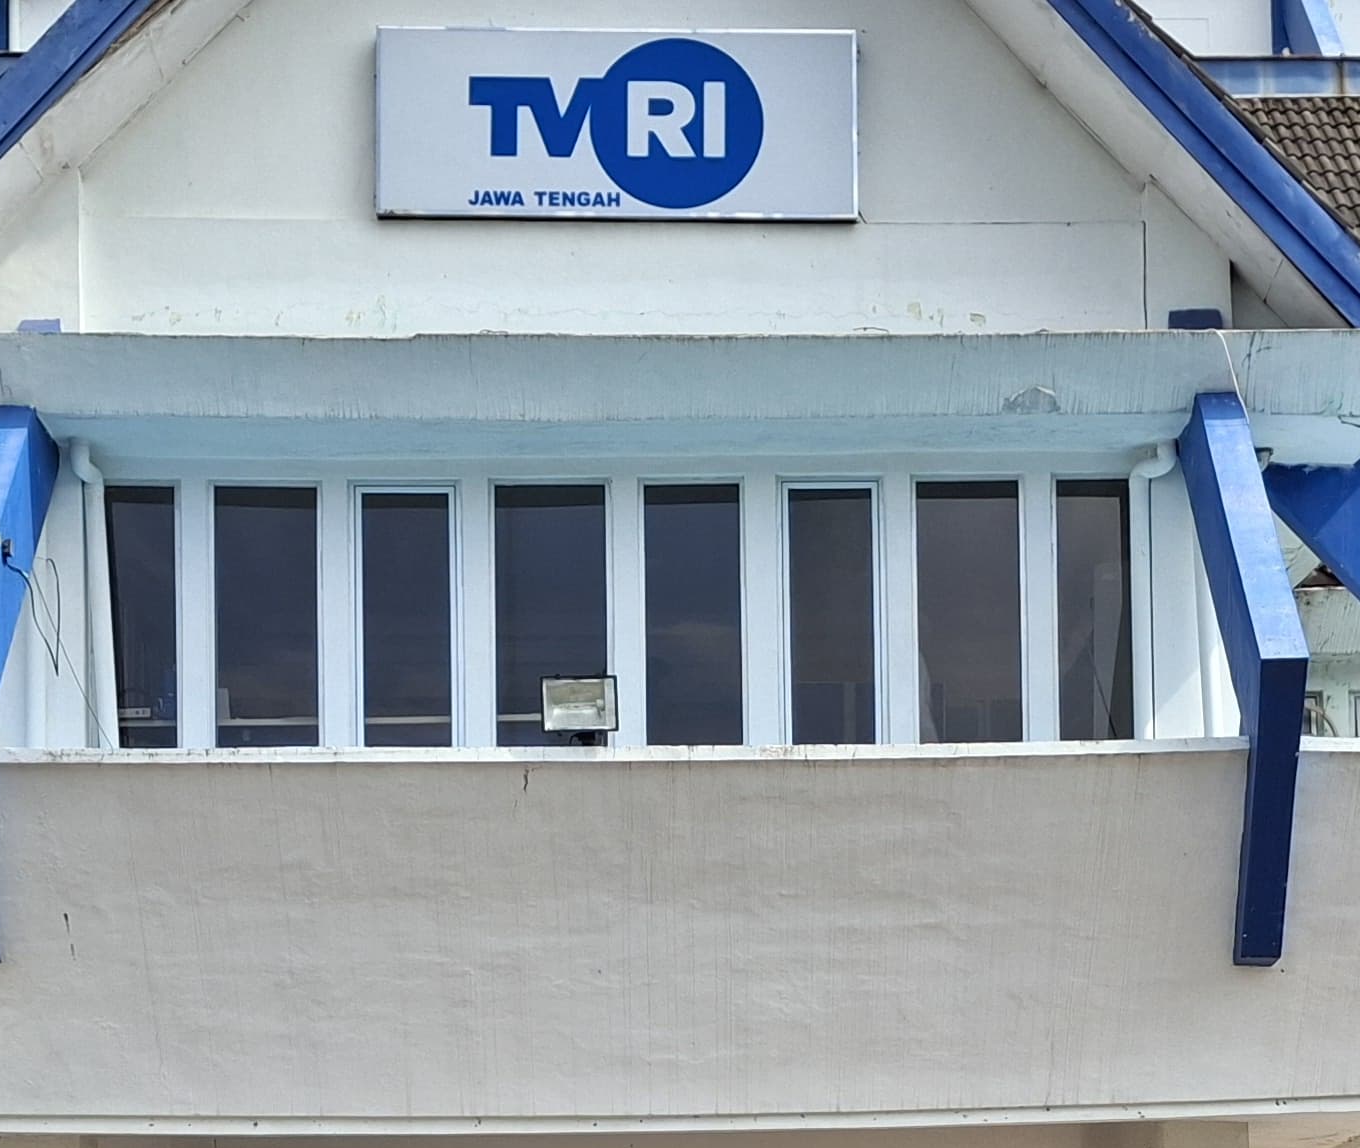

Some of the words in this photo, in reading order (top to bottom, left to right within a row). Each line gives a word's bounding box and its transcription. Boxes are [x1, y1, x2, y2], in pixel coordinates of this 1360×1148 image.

[469, 76, 726, 158] TVRI
[468, 190, 524, 206] JAWA
[534, 191, 621, 207] TENGAH
